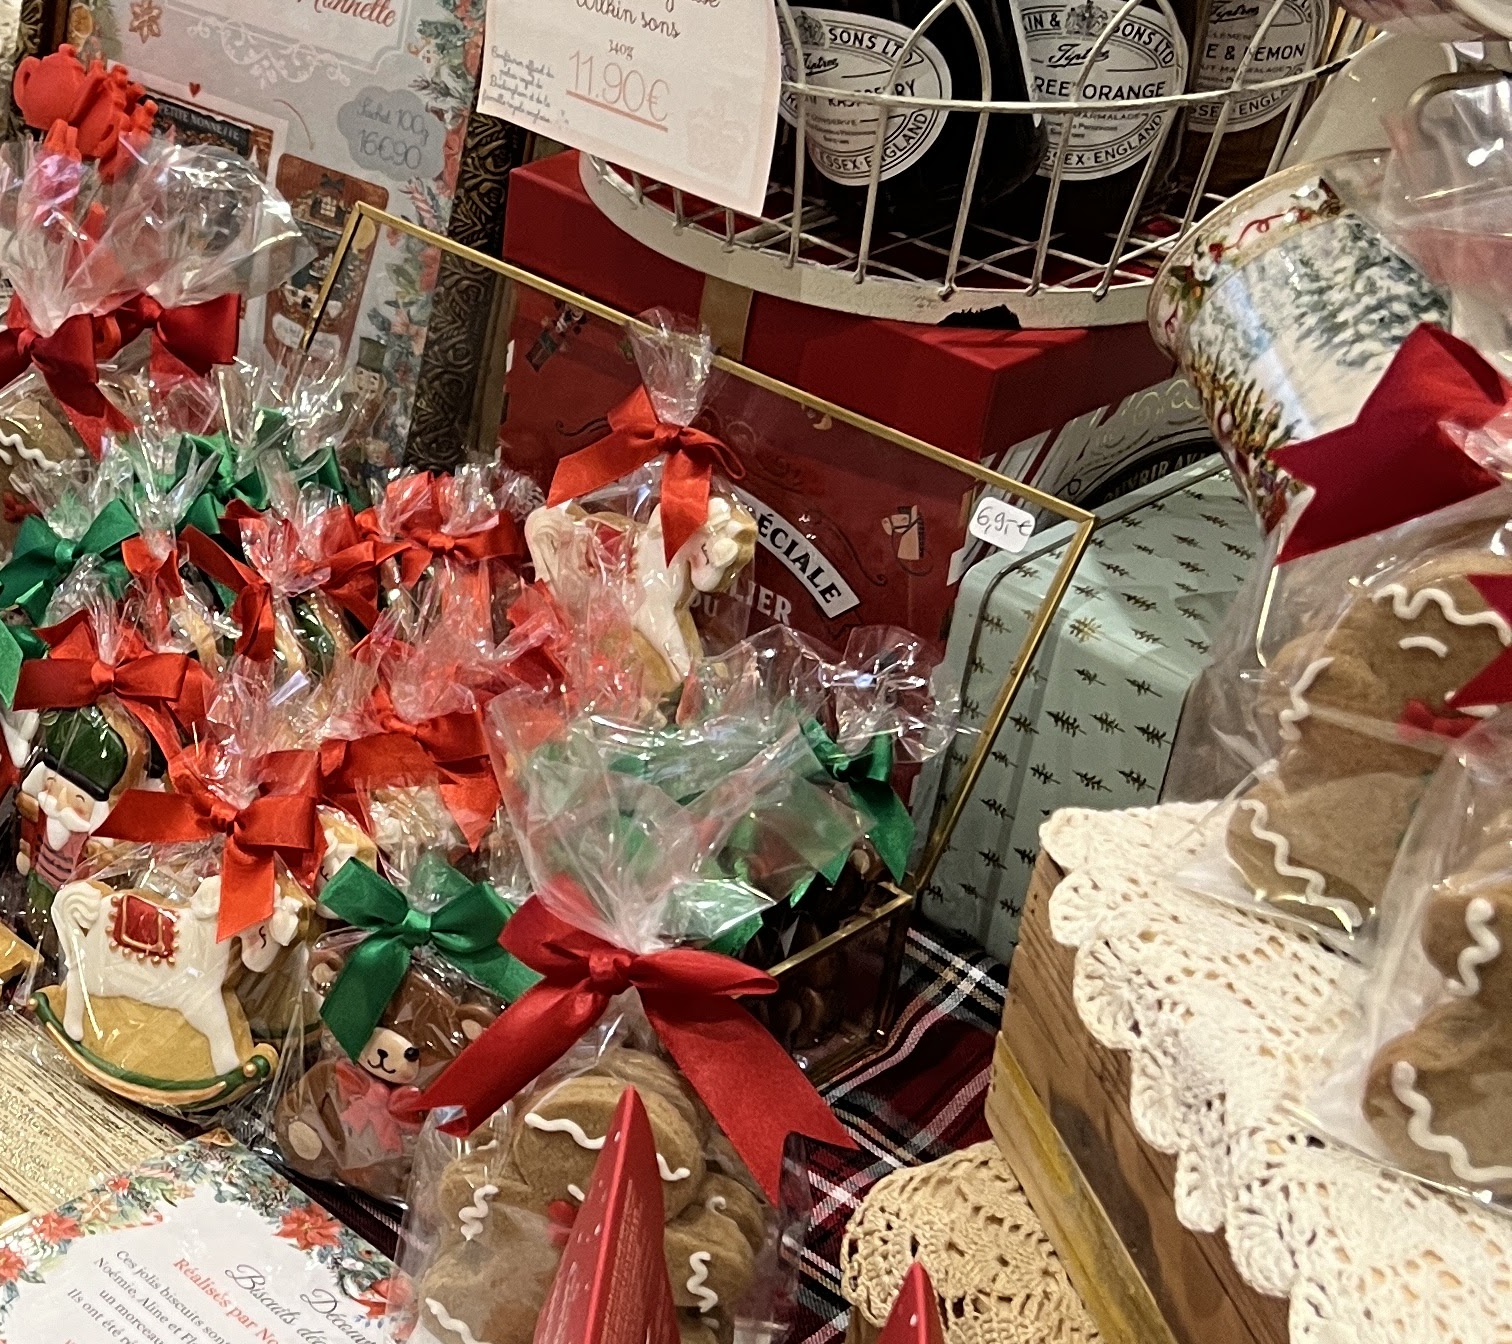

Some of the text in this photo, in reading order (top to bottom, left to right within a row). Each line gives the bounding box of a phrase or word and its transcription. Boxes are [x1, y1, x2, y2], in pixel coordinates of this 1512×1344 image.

[641, 10, 681, 39] sons
[828, 27, 877, 50] SONS
[1154, 35, 1175, 65] LTD
[569, 50, 670, 123] 11.90€
[1083, 80, 1166, 100] ORANGE
[1094, 113, 1163, 164] ENGLAND
[758, 512, 842, 605] ÉCIALE
[93, 1256, 138, 1298] Noémie,
[137, 1296, 169, 1323] Aline
[116, 1250, 137, 1269] Ces
[133, 1266, 161, 1290] jolis
[159, 1286, 204, 1327] biscuits
[173, 1257, 230, 1307] Réalisés
[225, 1306, 257, 1330] par
[224, 1262, 300, 1325] Biscuits
